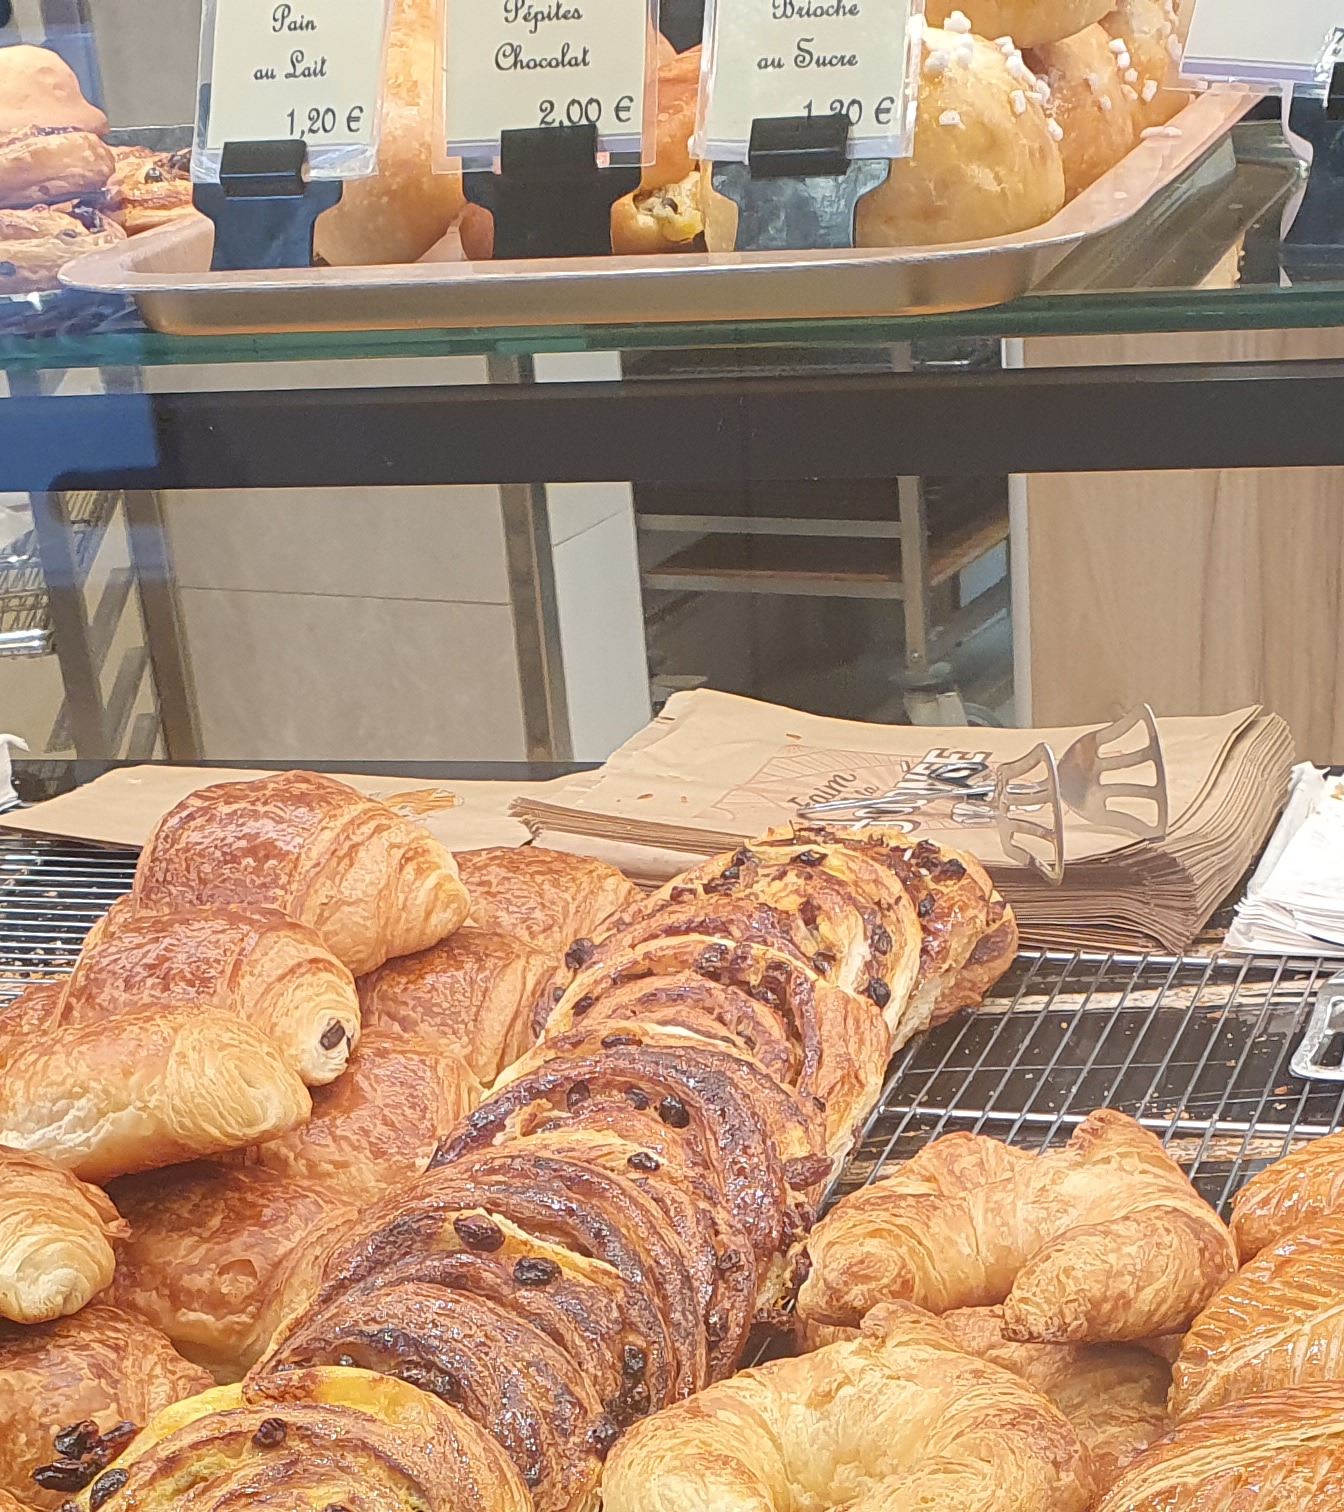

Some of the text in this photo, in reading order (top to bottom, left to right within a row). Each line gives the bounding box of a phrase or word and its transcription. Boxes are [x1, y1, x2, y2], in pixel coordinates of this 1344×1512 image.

[272, 4, 317, 33] Pain
[503, 0, 583, 34] Pépites
[772, 0, 860, 19] Brioche
[253, 50, 328, 81] au Lait
[494, 42, 590, 71] Chocolat
[757, 37, 859, 69] au Sucre
[286, 105, 364, 139] 1,20 €
[539, 95, 635, 128] 2,00 €
[803, 96, 895, 126] 120 €
